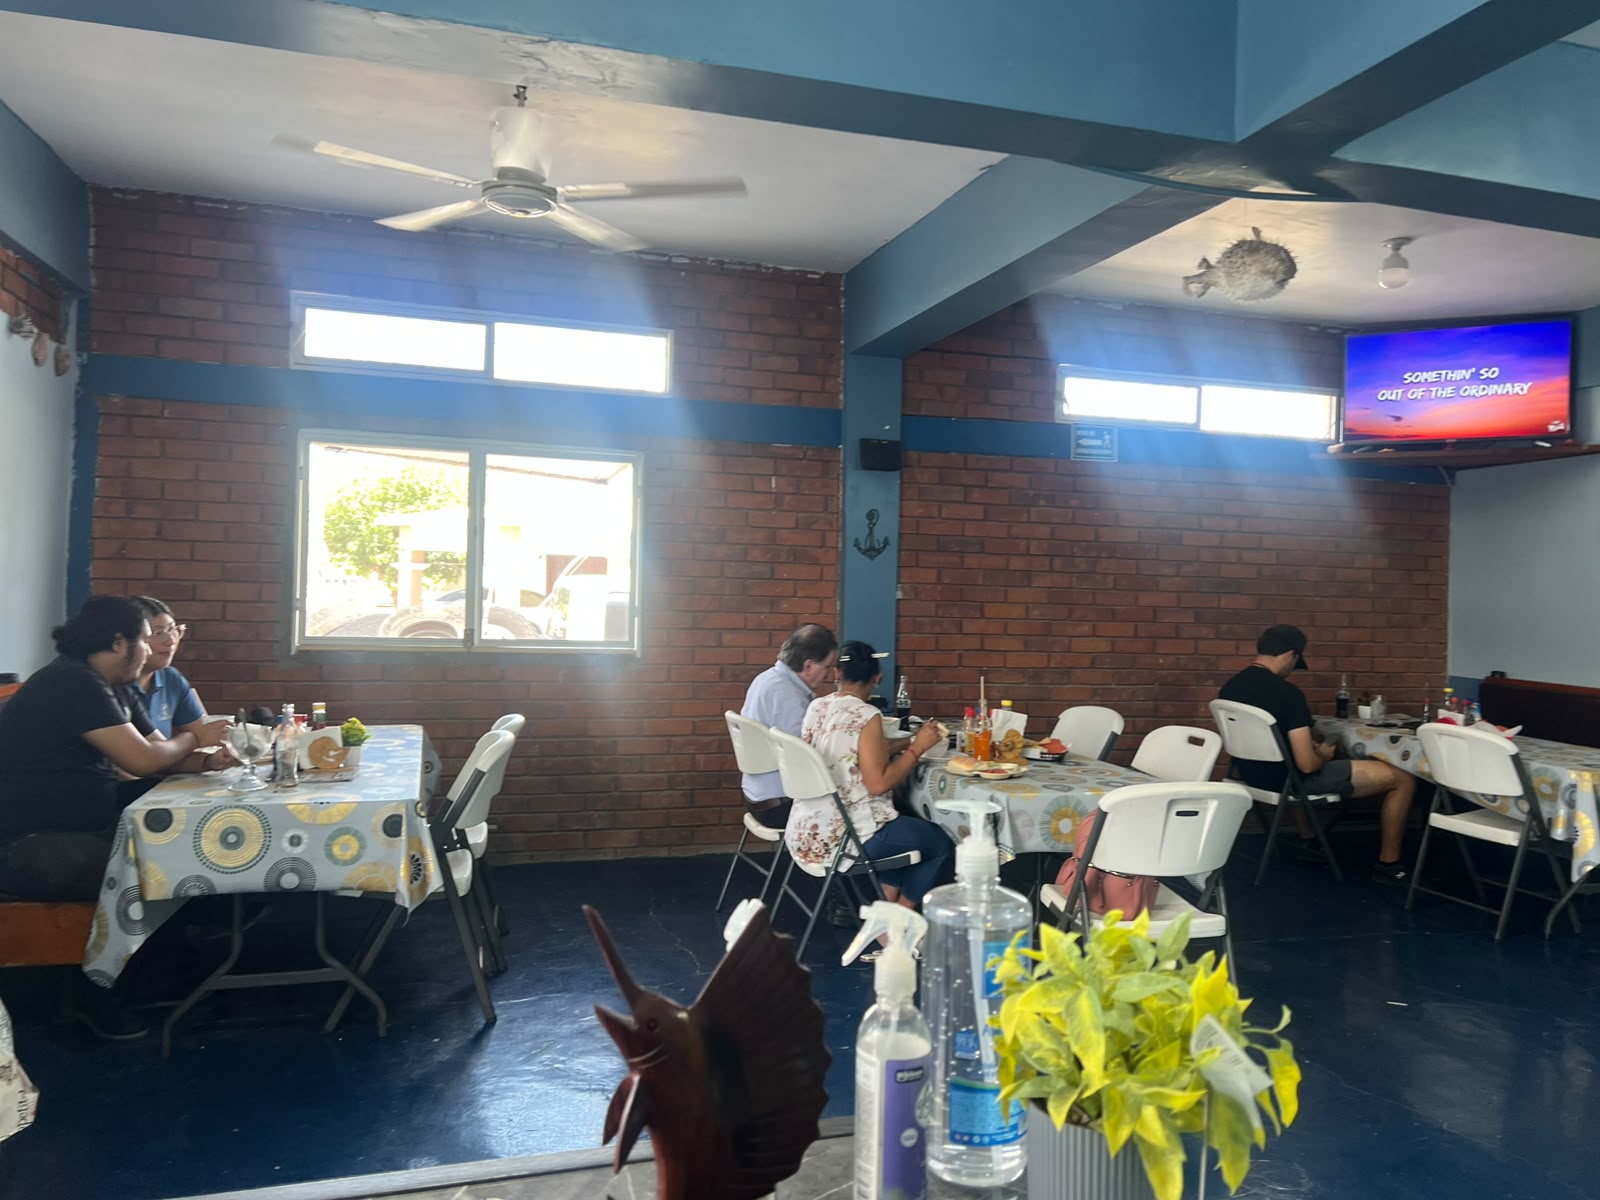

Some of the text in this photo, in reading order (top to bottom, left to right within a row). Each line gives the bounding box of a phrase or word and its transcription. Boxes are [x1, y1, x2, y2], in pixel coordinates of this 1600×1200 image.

[1403, 367, 1500, 384] SOMETHIN' SO
[1377, 382, 1533, 401] OUT OF THE ORDINARY
